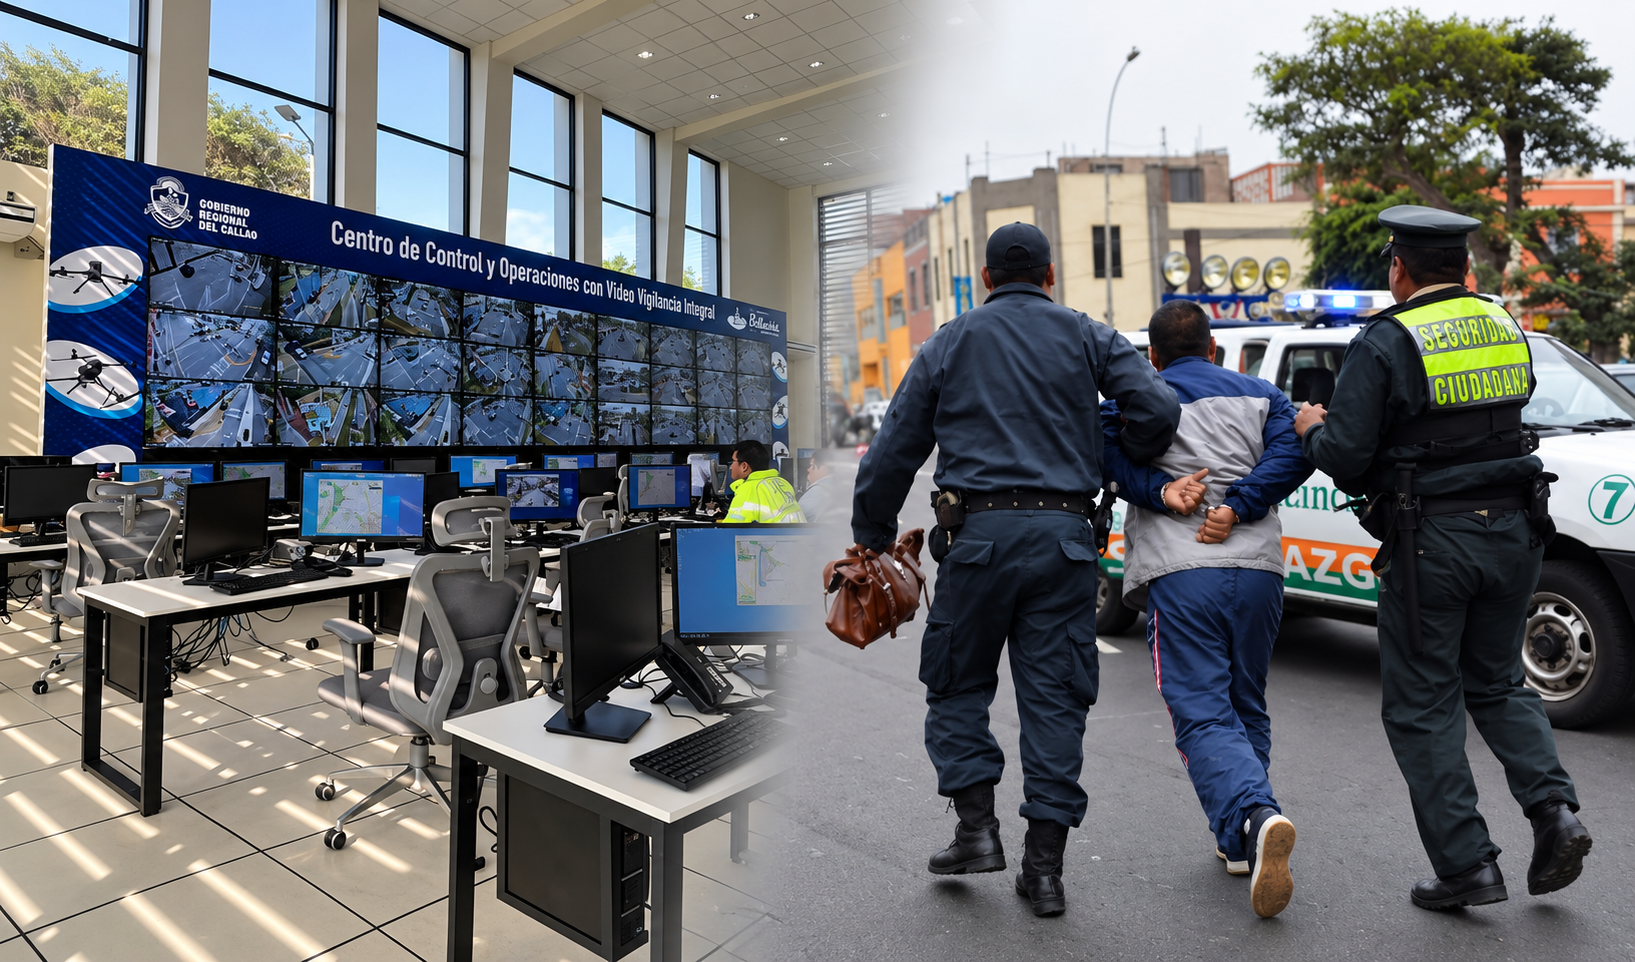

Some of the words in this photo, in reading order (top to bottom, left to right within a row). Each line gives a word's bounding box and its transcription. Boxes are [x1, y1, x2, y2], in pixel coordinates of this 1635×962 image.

[199, 199, 250, 217] GOBIERNO
[199, 210, 248, 228] REGIONAL
[199, 220, 218, 233] DEL
[221, 225, 258, 240] CALLAO
[331, 220, 394, 256] Centro
[399, 235, 420, 261] de
[425, 241, 483, 274] Control
[486, 259, 495, 280] y
[500, 257, 580, 292] Operaciones
[583, 280, 603, 297] con
[606, 280, 635, 303] Video
[637, 287, 682, 311] Vigilancia
[684, 298, 716, 321] Integral
[1434, 366, 1528, 406] CIUDADANA
[1603, 481, 1629, 519] 7
